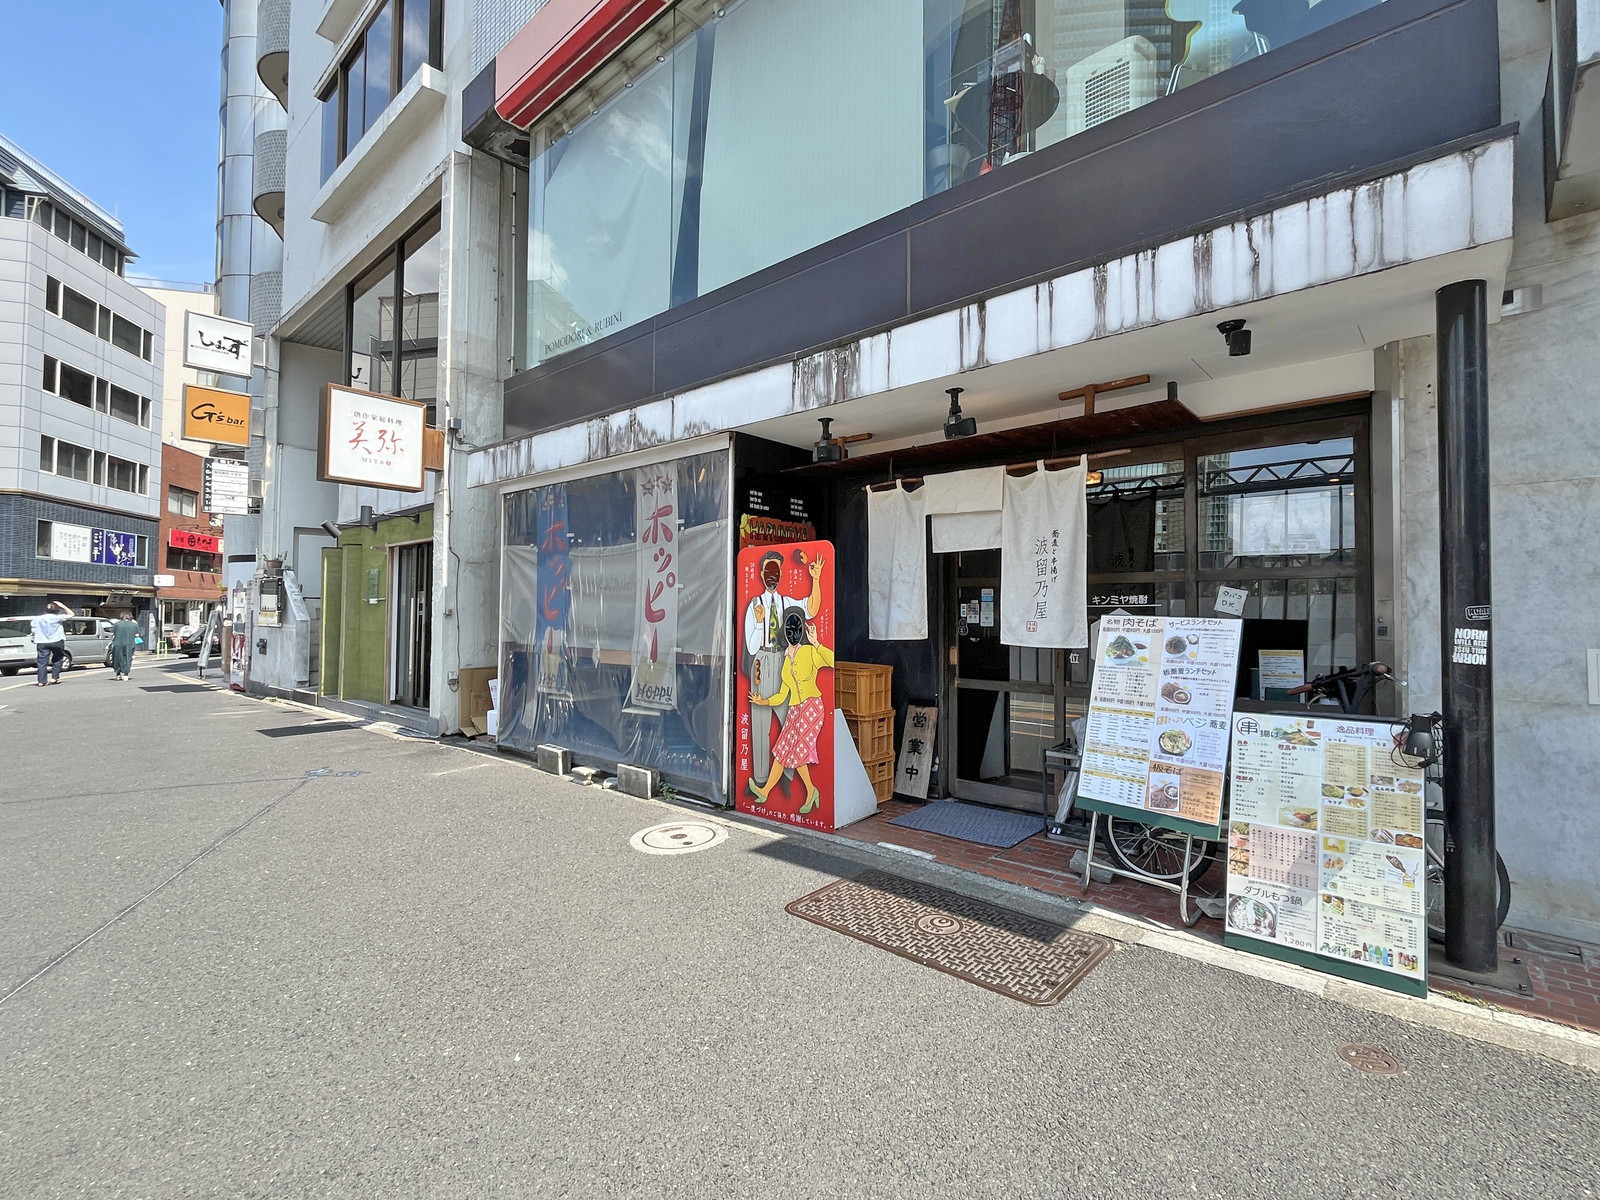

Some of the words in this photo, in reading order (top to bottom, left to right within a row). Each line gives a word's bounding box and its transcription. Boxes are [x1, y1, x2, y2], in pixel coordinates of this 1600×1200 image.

[594, 312, 622, 332] RUBINI
[226, 416, 245, 426] bar
[641, 503, 676, 664] ホッピー
[1032, 536, 1049, 620] 波留乃屋
[1092, 594, 1148, 605] キンミヤ焼酎
[1122, 618, 1159, 628] 肉そば
[1168, 619, 1223, 628] サービスランチセット
[1455, 628, 1488, 641] NORM
[635, 683, 673, 702] Hoppy
[1183, 717, 1207, 728] ベジ
[1240, 720, 1258, 735] 串
[1336, 725, 1375, 736] 逸品料理
[740, 713, 750, 771] 波留乃屋
[905, 711, 927, 782] 営業中
[1243, 885, 1303, 907] ダブルもつ鍋
